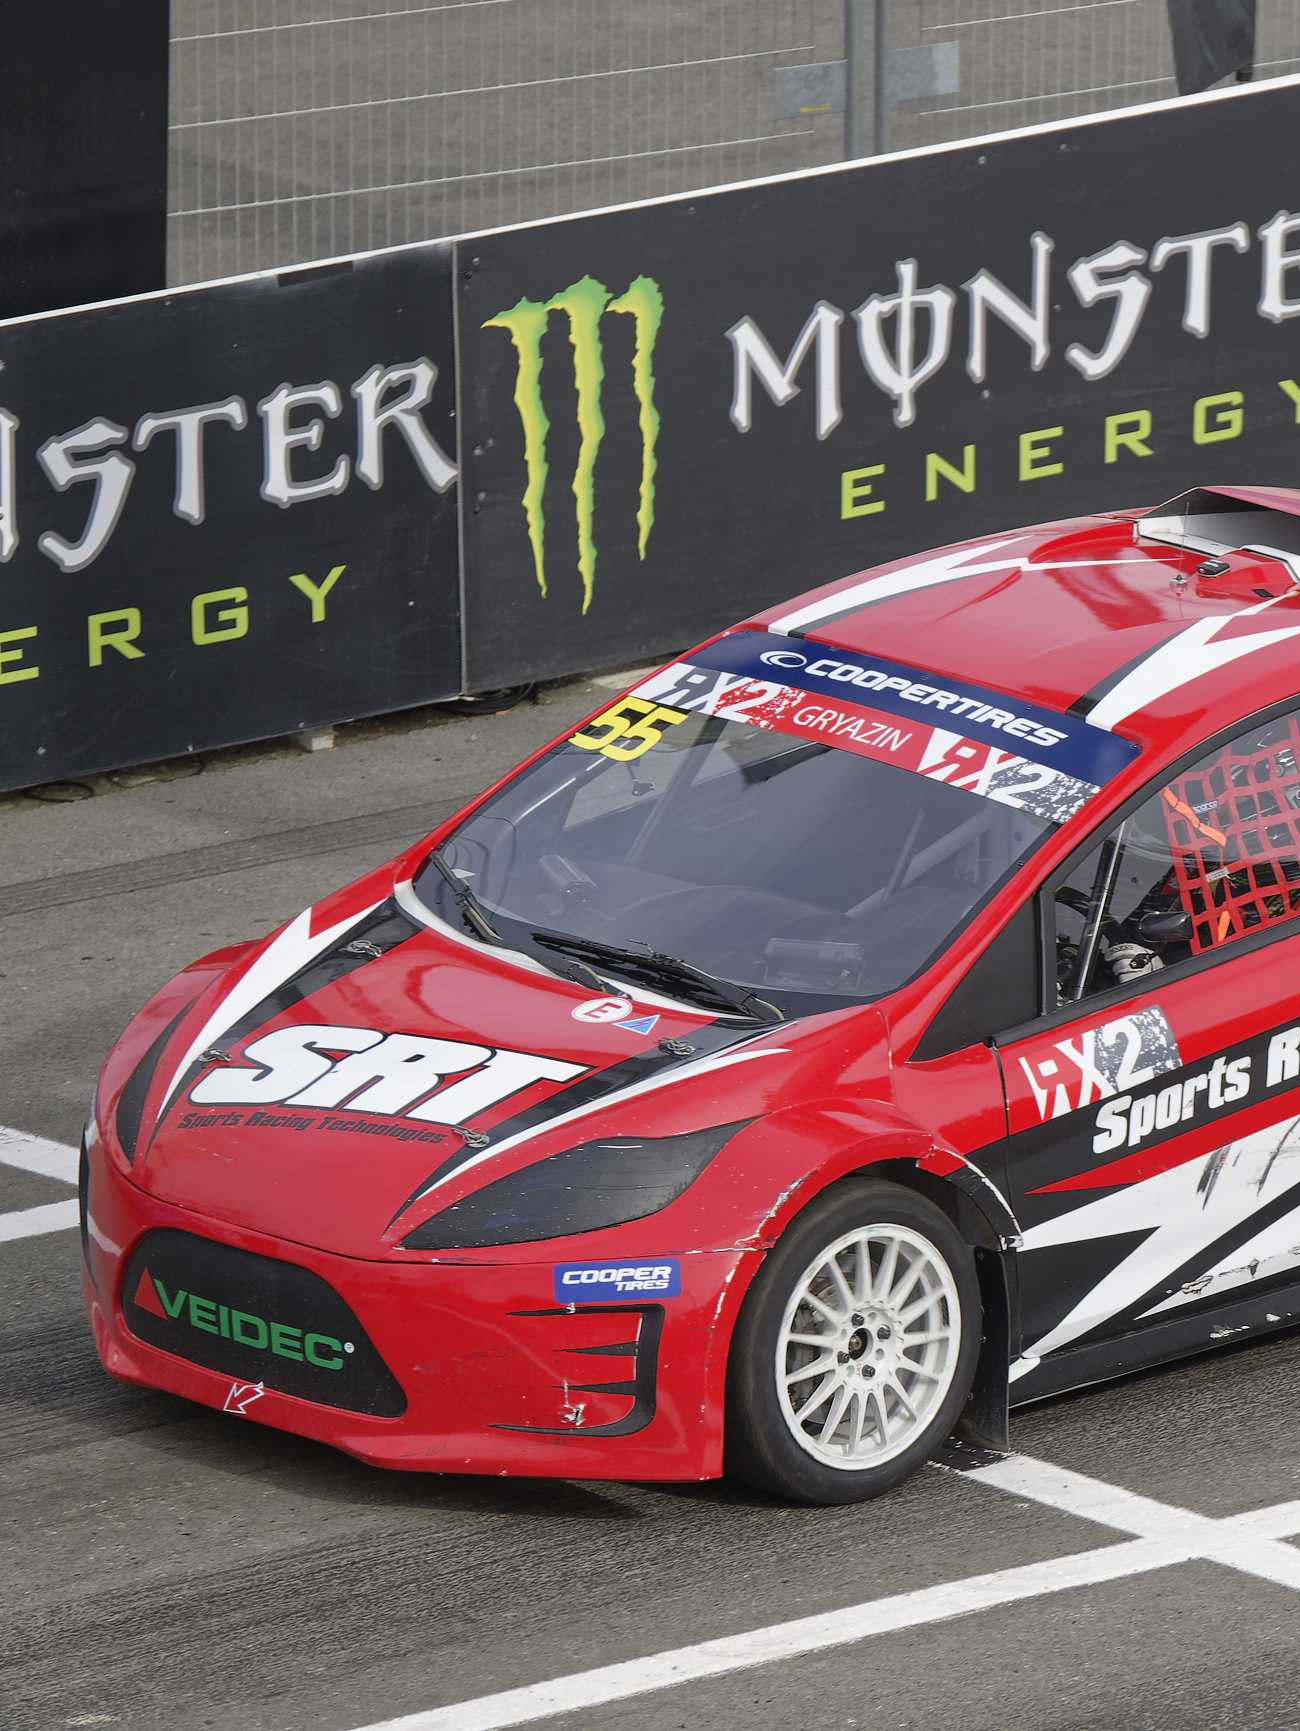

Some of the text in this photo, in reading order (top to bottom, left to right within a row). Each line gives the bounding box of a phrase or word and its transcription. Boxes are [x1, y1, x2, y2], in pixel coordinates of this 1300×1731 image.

[568, 695, 689, 762] 55
[792, 705, 913, 751] GRYAZIN
[188, 1024, 598, 1126] SRT
[178, 1111, 450, 1144] Sports Racing Technologies
[1092, 1056, 1251, 1154] Sports
[562, 1265, 673, 1285] COOPER
[614, 1279, 670, 1291] TIRES
[153, 1278, 345, 1371] VEIDEC
